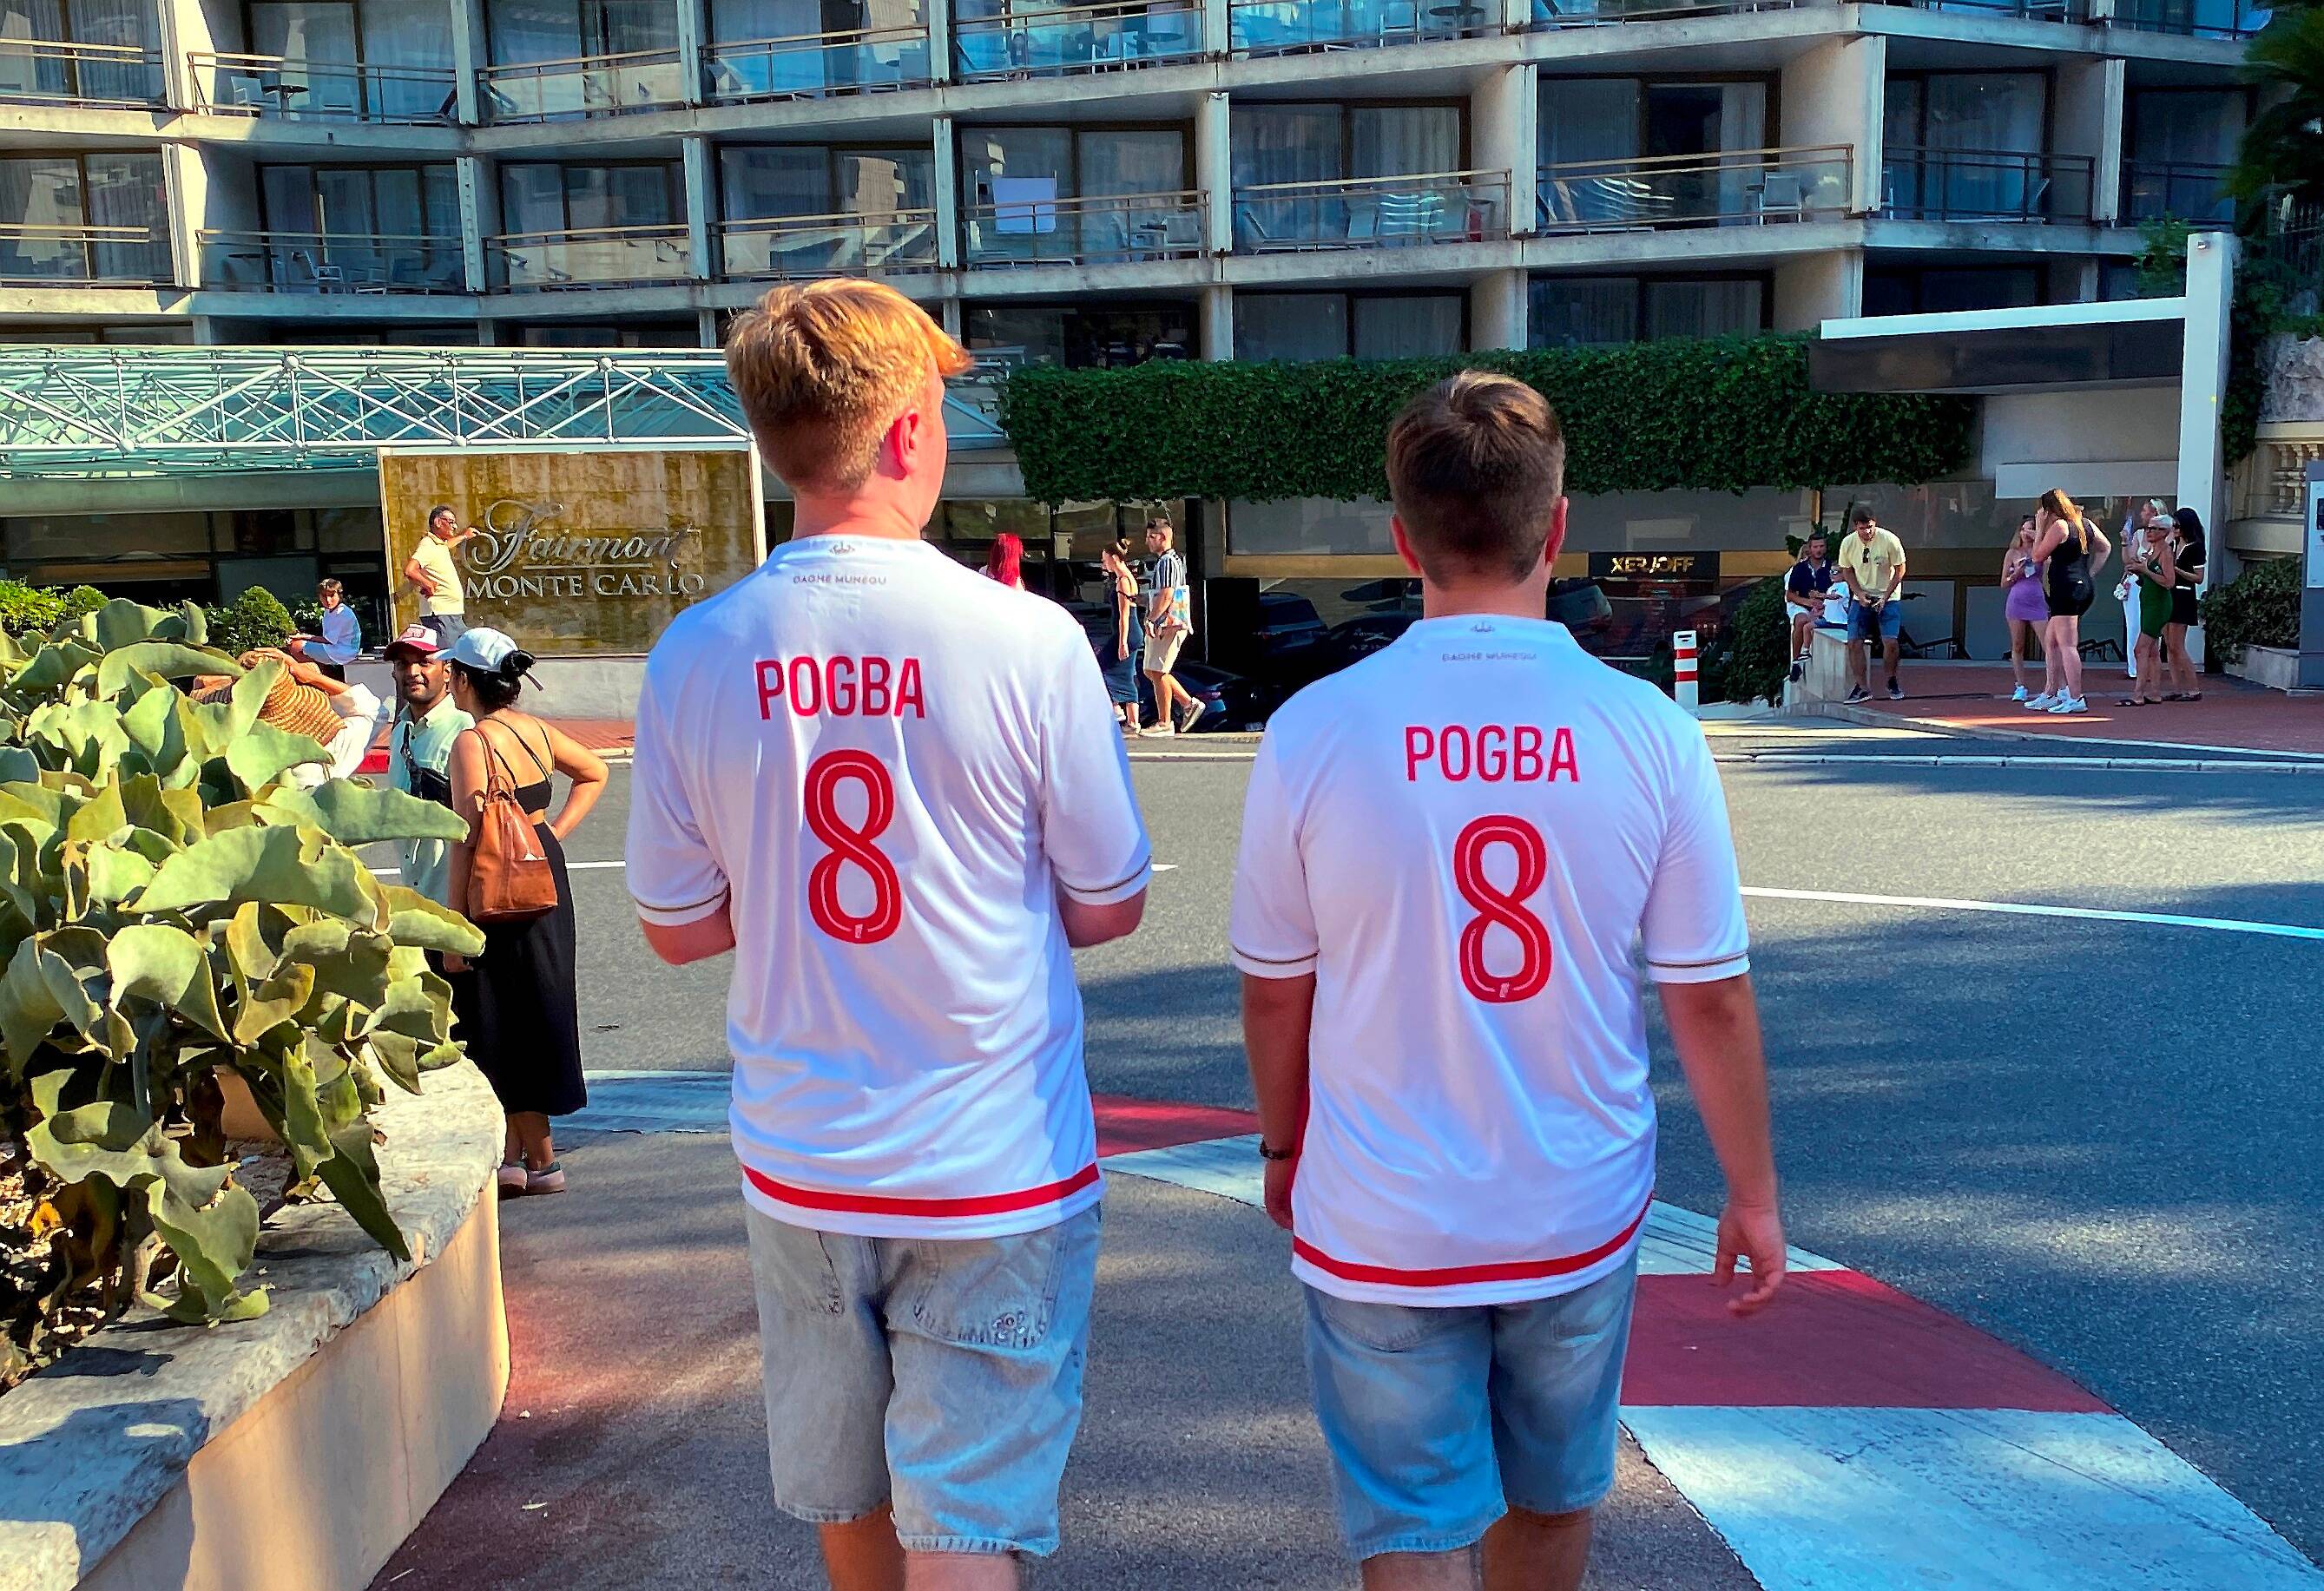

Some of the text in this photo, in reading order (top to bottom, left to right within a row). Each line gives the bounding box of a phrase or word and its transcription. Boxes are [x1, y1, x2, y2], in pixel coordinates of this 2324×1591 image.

[461, 499, 702, 575] Fairmont
[464, 573, 706, 599] MONTE CARLO
[755, 655, 925, 720] POGBA
[1405, 725, 1580, 783] POGBA
[804, 749, 903, 944] 8
[1453, 814, 1553, 1003] 8
